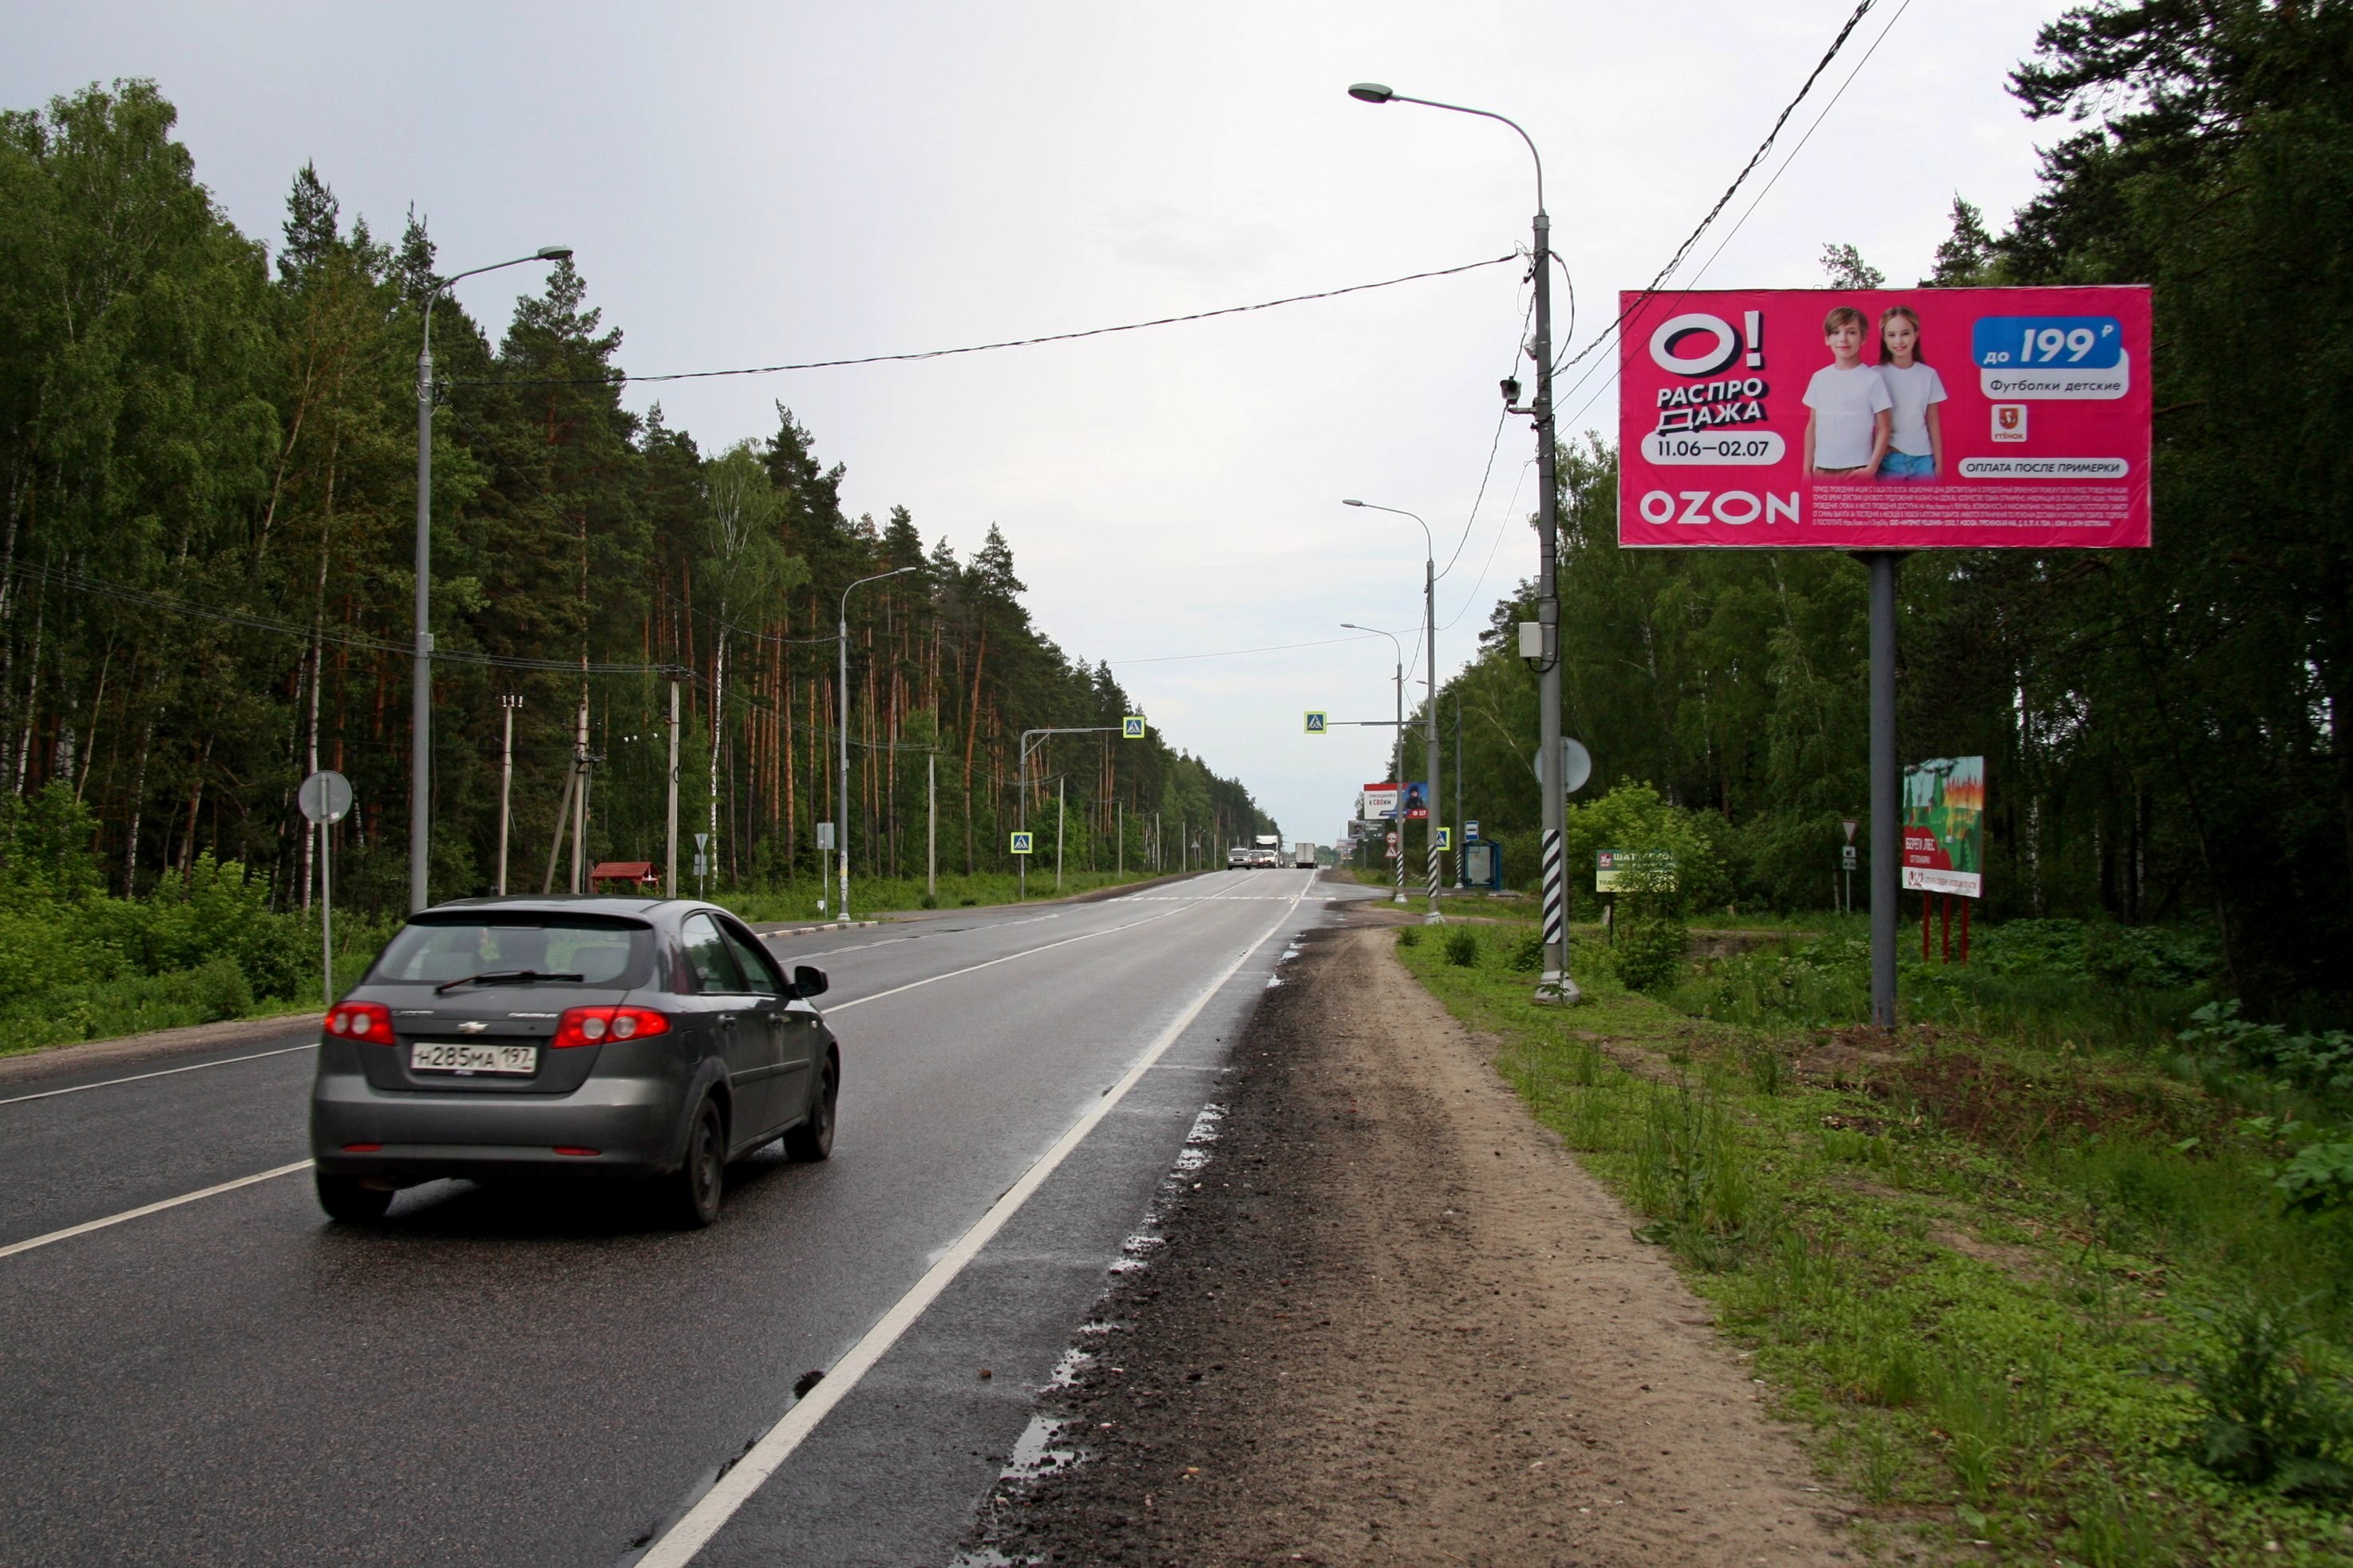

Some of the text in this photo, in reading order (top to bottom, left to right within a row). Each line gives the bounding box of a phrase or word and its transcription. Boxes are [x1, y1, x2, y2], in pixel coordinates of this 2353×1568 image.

[1649, 310, 1763, 377] О!
[1655, 377, 1766, 409] РАСПРО
[1990, 379, 2121, 393] Футболки детские
[1655, 400, 1764, 436] ДАЖА
[1966, 463, 2121, 472] ОПЛАТА ПОСЛЕ ПРИМЕРКИ
[1639, 490, 1800, 525] OZON
